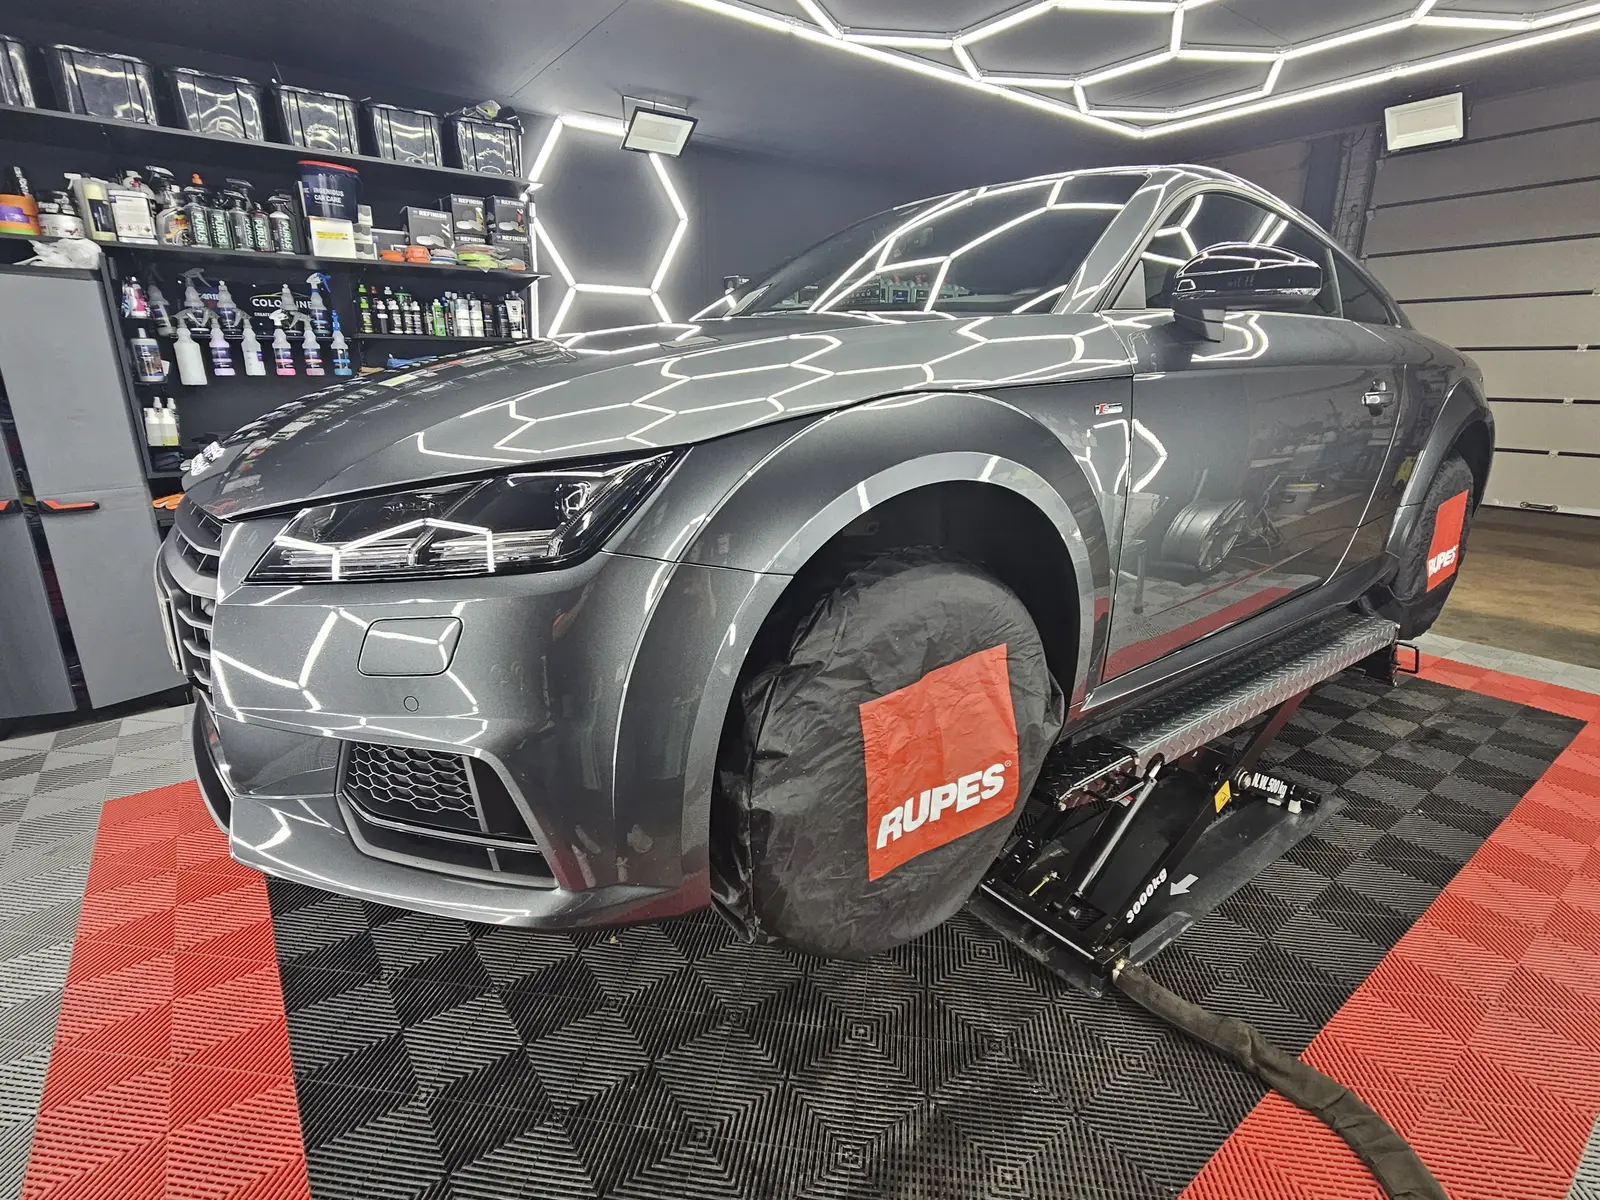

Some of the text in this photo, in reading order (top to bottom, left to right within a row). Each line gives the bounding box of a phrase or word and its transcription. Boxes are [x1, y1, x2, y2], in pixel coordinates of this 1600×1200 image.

[313, 187, 345, 197] INGENIOUS
[326, 195, 342, 203] CARE
[458, 197, 484, 206] REFINISH
[500, 199, 526, 207] REFINISH
[418, 210, 447, 219] REFINISH
[193, 212, 209, 244] PURUS
[214, 214, 229, 248] PURUS
[254, 218, 266, 250] PURUS
[281, 220, 294, 251] PURUS
[502, 234, 528, 242] REFINISH
[460, 235, 486, 243] REFINISH
[1428, 546, 1457, 578] RUPES
[876, 762, 1006, 850] RUPES
[1125, 867, 1168, 924] 3000kg
